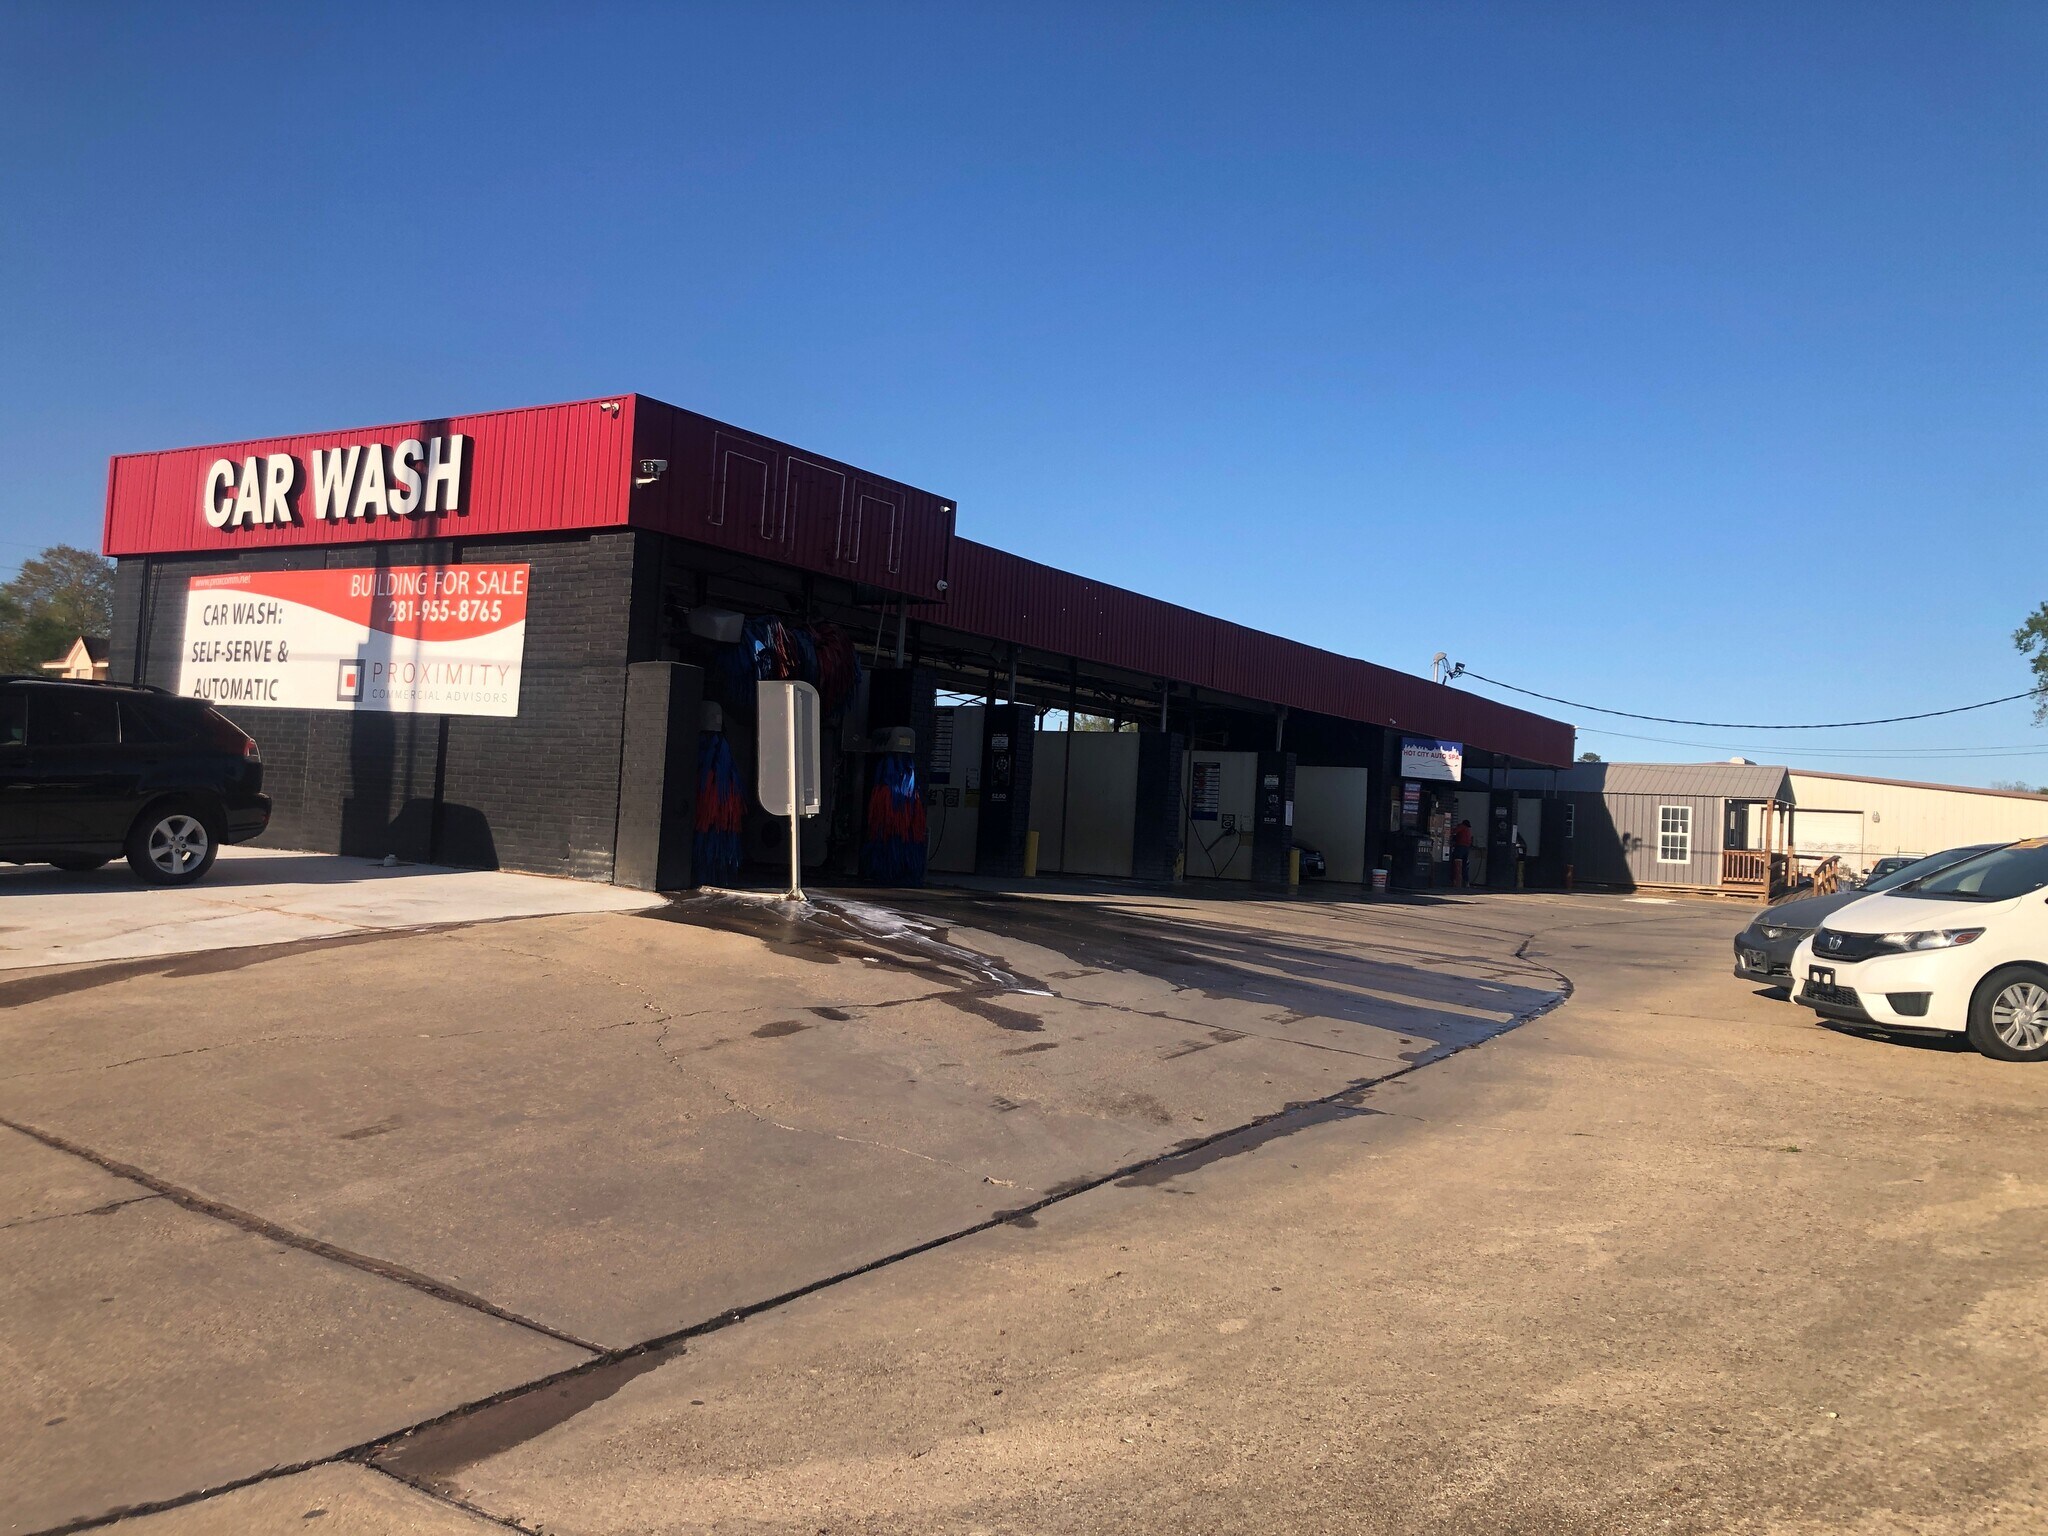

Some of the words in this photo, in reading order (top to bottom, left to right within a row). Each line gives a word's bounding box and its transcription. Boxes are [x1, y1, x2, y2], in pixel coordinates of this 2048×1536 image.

[205, 453, 295, 528] CAR
[312, 433, 464, 520] WASH
[351, 573, 428, 597] BUILDING
[433, 571, 470, 595] FOR
[476, 570, 525, 595] SALE
[203, 604, 229, 626] CAR
[233, 602, 283, 625] WASH:
[387, 599, 503, 623] 281-955-8765
[191, 640, 273, 663] SELF-SERVE
[277, 640, 289, 663] &
[372, 662, 511, 686] PROXIMITY
[193, 678, 279, 701] AUTOMATIC
[372, 688, 440, 701] COMMERCIAL
[446, 691, 508, 703] ADVISORS
[1431, 752, 1447, 760] AUTO
